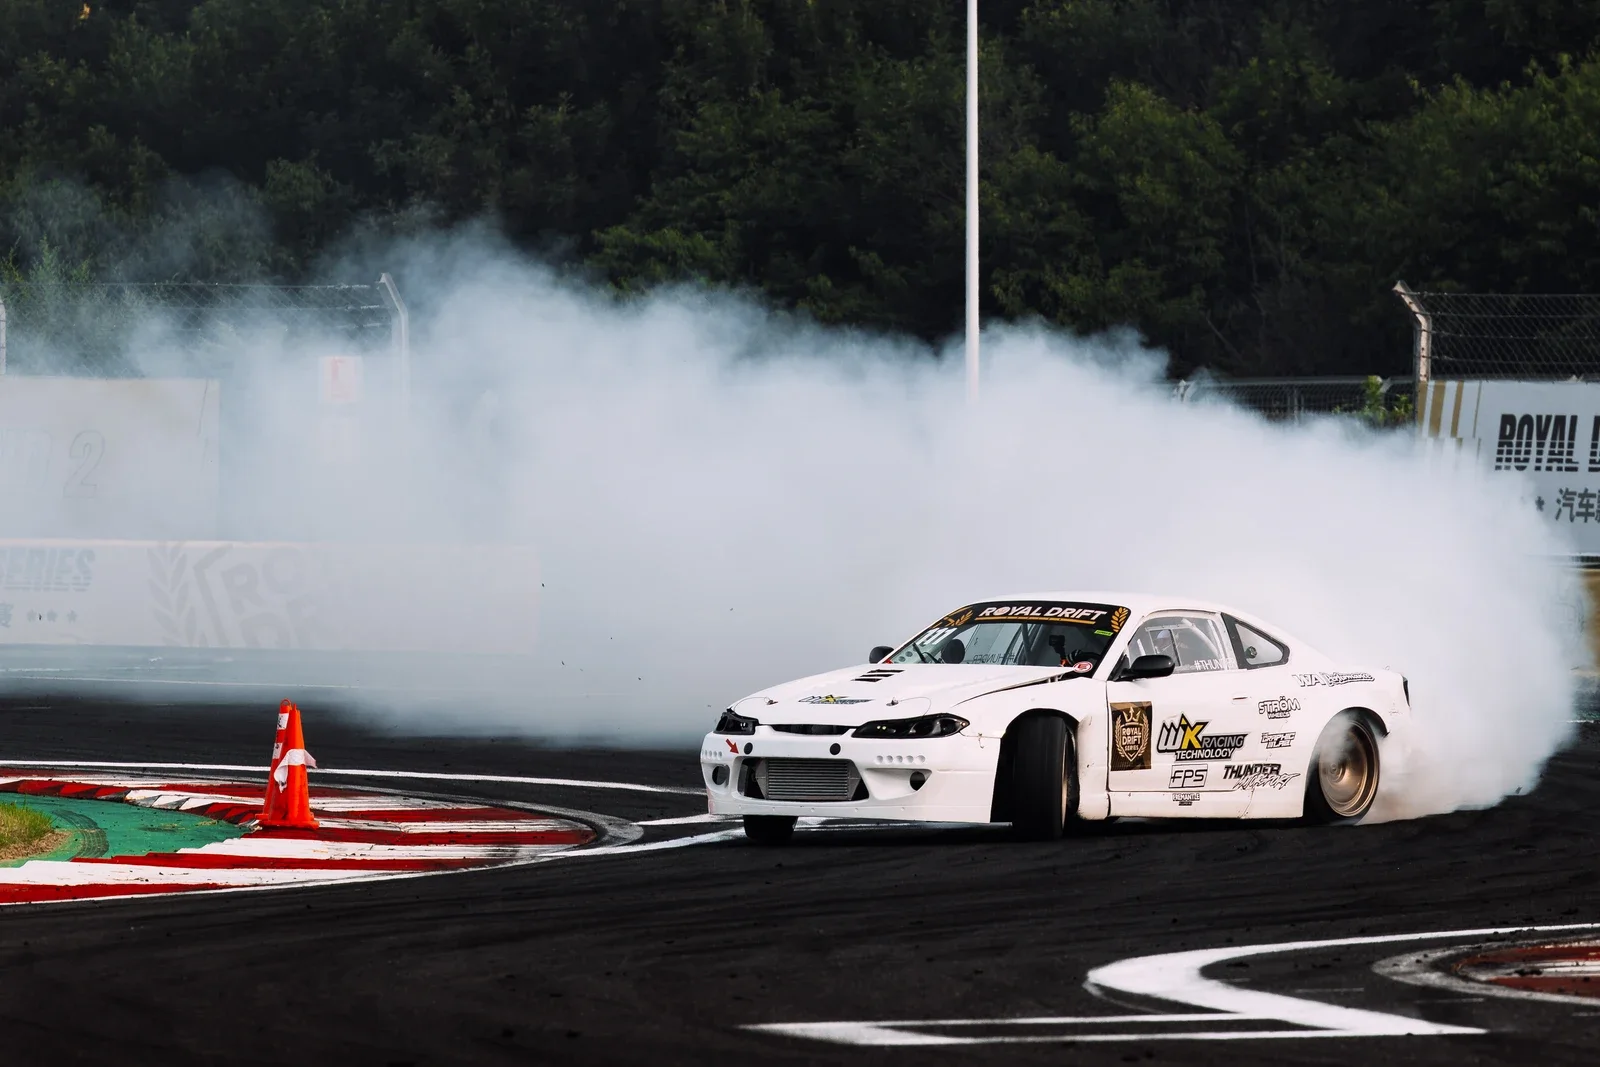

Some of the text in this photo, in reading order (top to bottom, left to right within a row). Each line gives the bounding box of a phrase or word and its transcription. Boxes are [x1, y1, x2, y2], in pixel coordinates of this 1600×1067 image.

[1494, 414, 1580, 472] ROYAL
[1554, 487, 1600, 523] 汽车
[0, 548, 96, 592] ERIES
[979, 606, 1108, 621] ROYAL DRIFT
[1258, 696, 1301, 714] STRÖM
[1122, 727, 1142, 736] ROYAL
[1122, 735, 1142, 746] DRIFT
[1202, 735, 1245, 749] RACING
[1175, 747, 1235, 760] TECHNOLOGY
[1171, 769, 1208, 788] FPS
[1223, 763, 1281, 779] THUNDER
